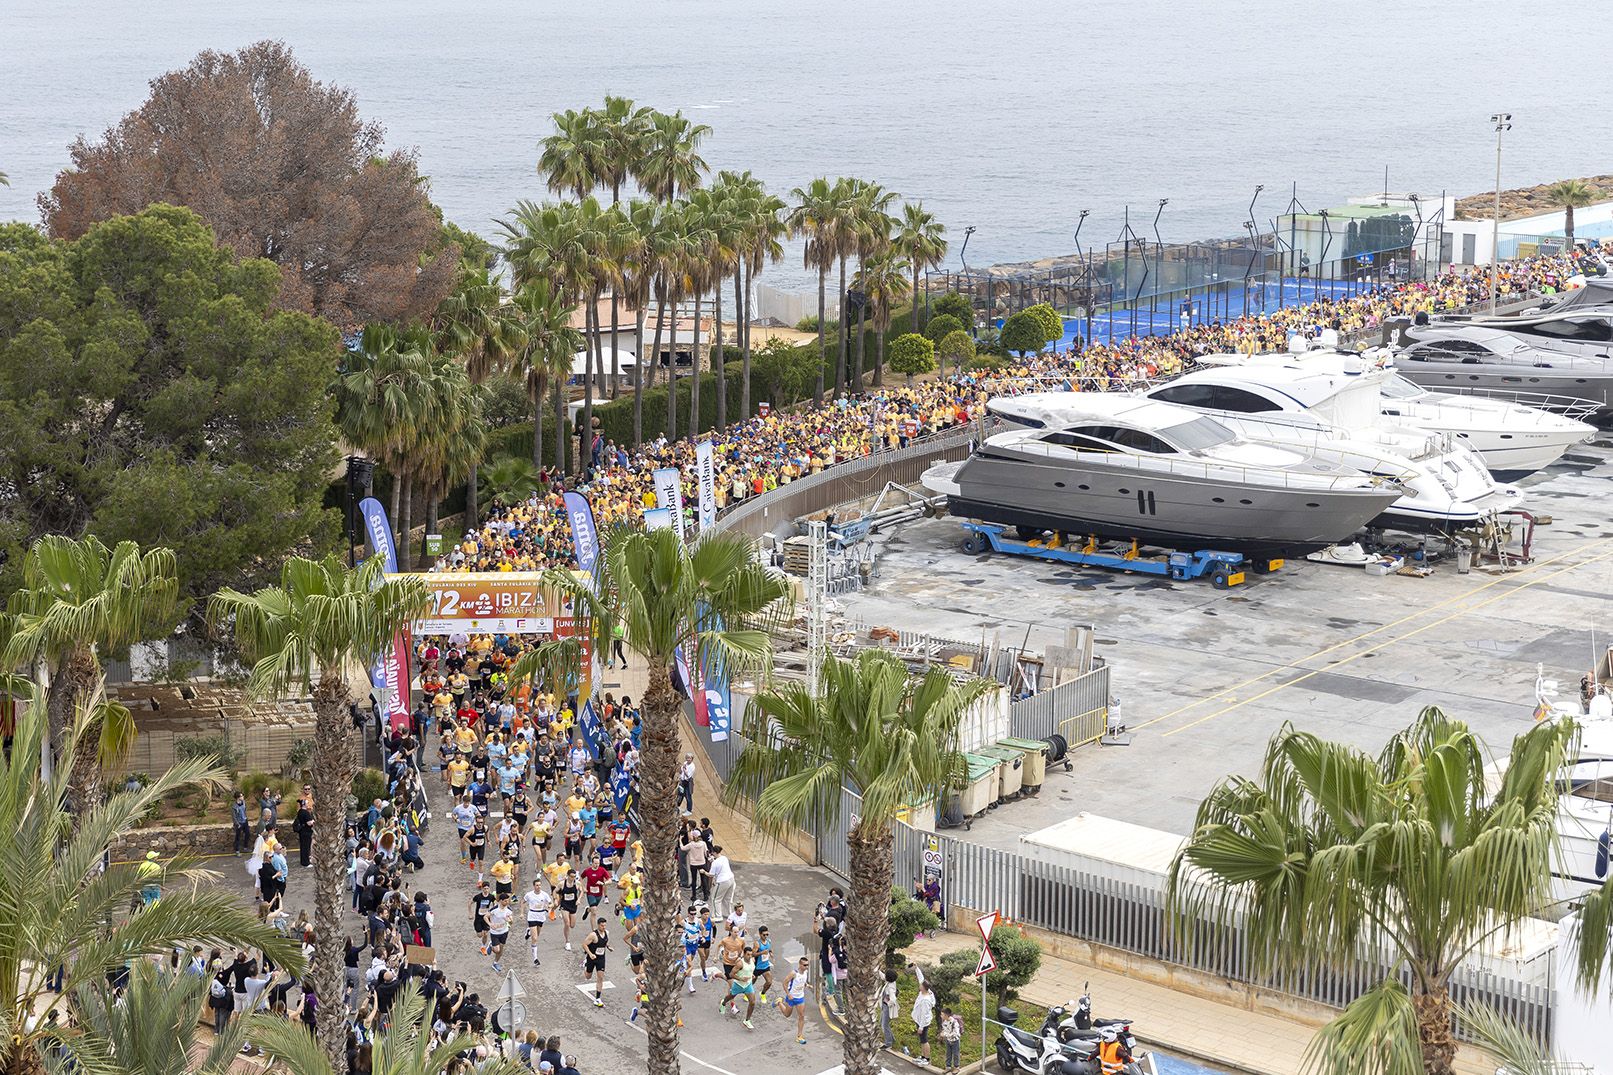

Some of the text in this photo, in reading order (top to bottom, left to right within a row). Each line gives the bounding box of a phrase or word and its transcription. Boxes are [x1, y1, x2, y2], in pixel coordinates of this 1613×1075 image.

[702, 456, 712, 512] CaixaBank
[663, 483, 679, 533] aixaBank
[460, 601, 475, 609] KM
[495, 592, 545, 607] IBIZA
